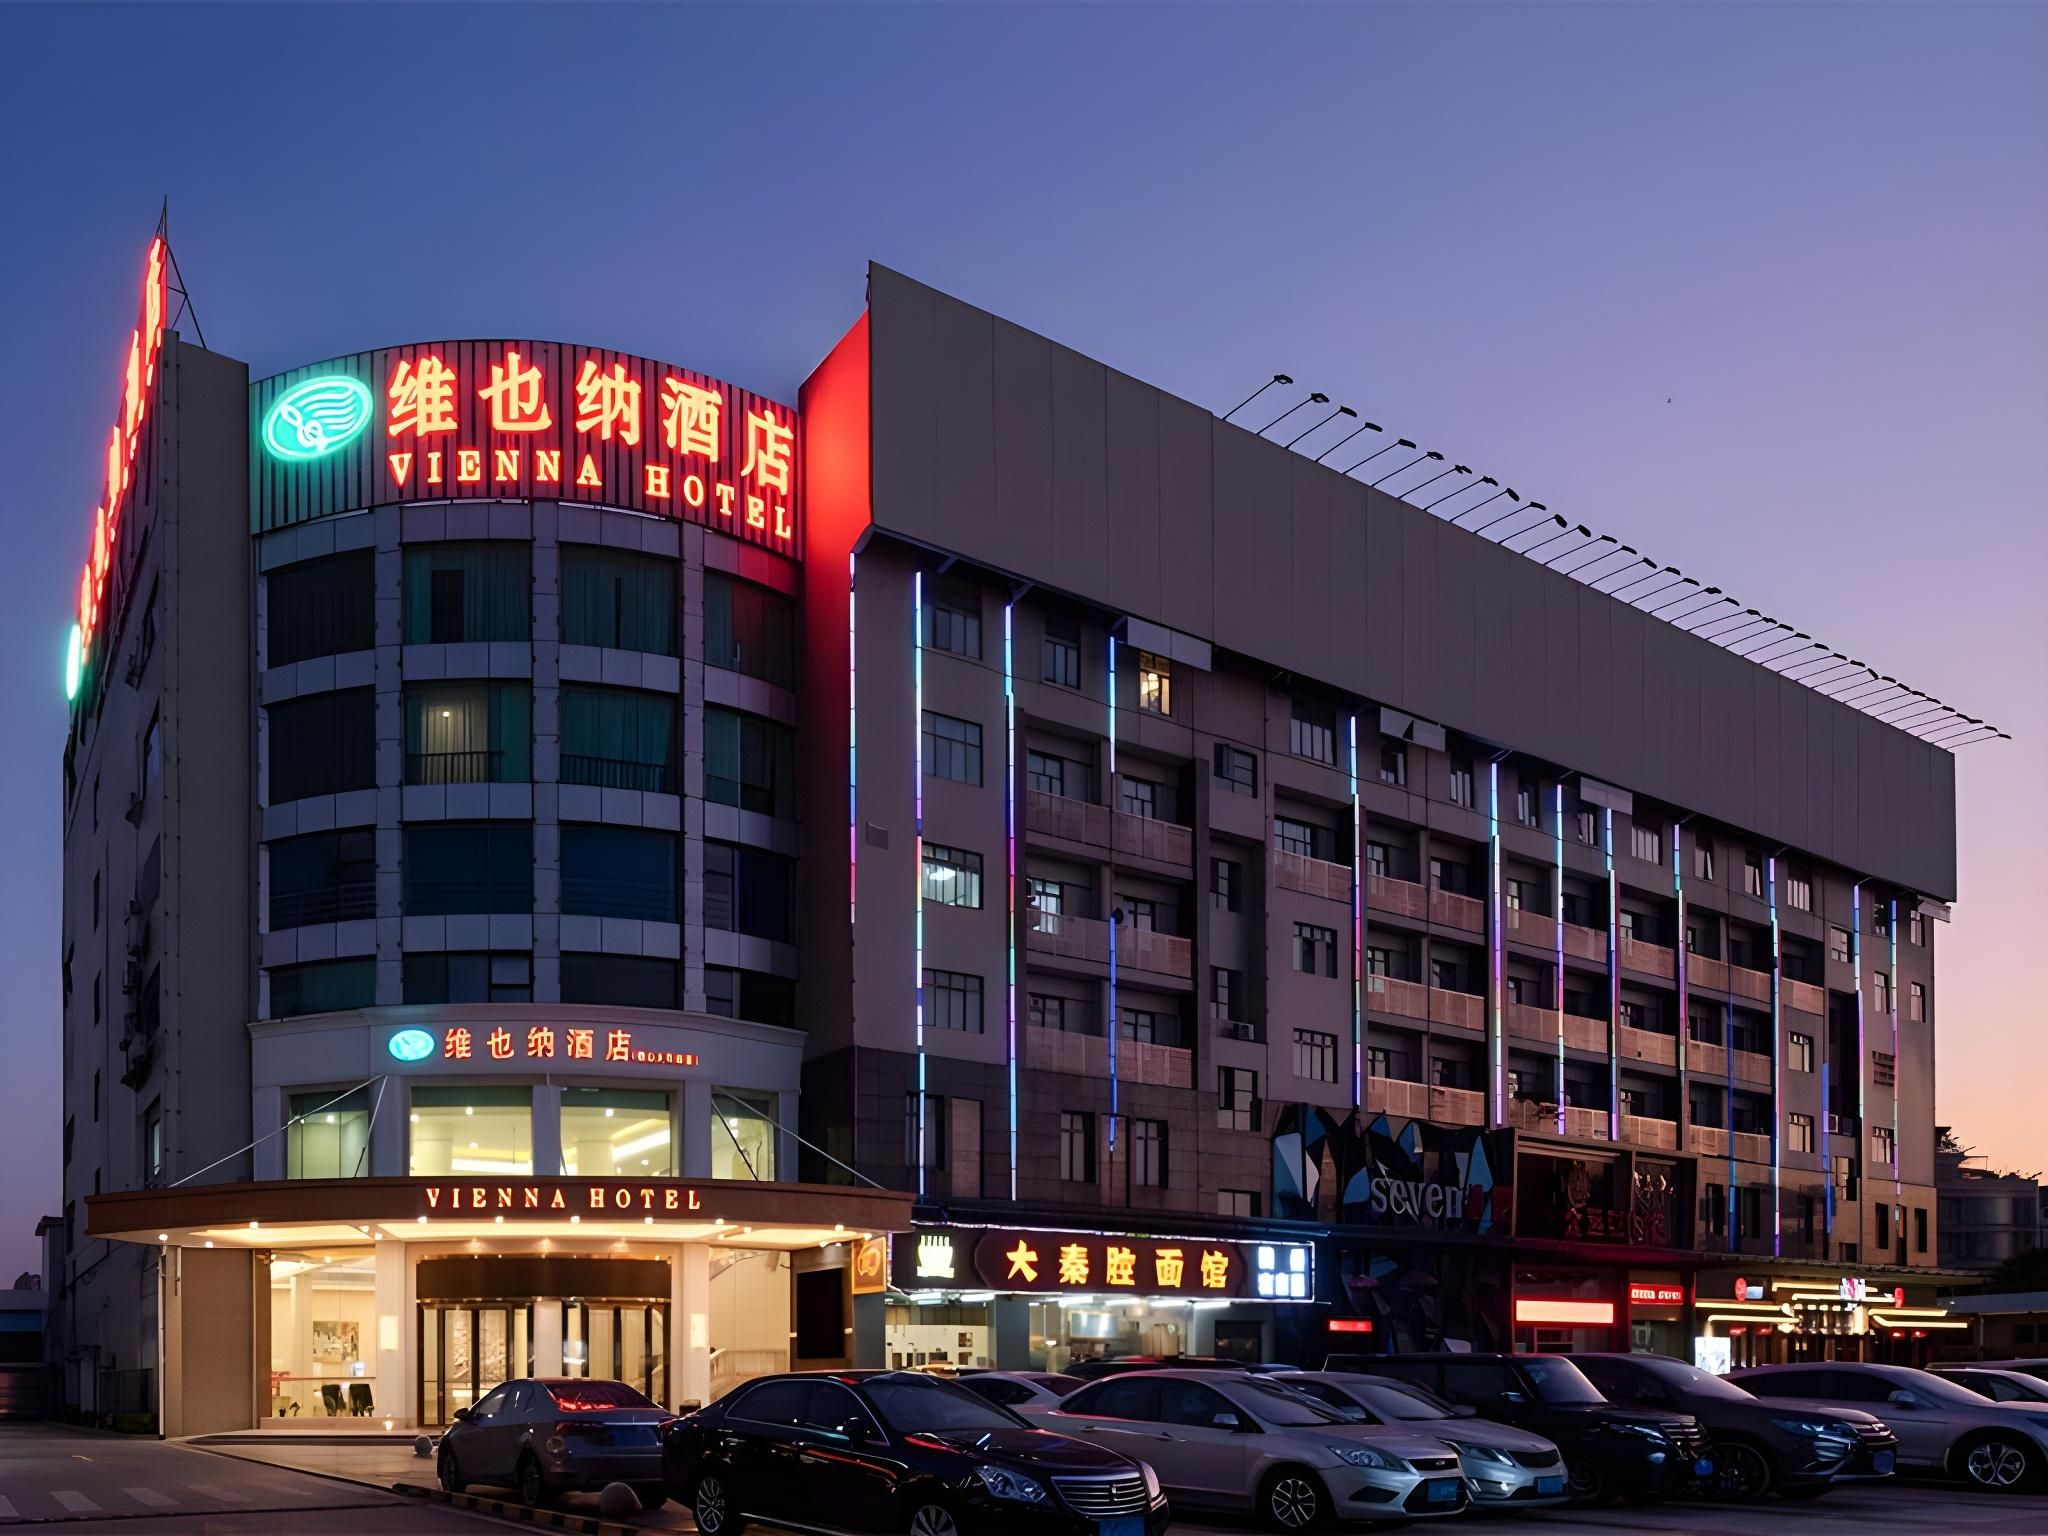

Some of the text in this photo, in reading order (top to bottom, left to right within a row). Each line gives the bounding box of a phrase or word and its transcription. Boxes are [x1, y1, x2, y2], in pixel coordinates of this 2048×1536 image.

[388, 351, 794, 496] 维也纳酒店
[388, 449, 793, 541] VIENNA HOTEL
[444, 1026, 632, 1062] 维也纳酒店
[425, 1187, 701, 1210] VIENNA HOTEL
[1005, 1239, 1230, 1288] 大秦腔面馆
